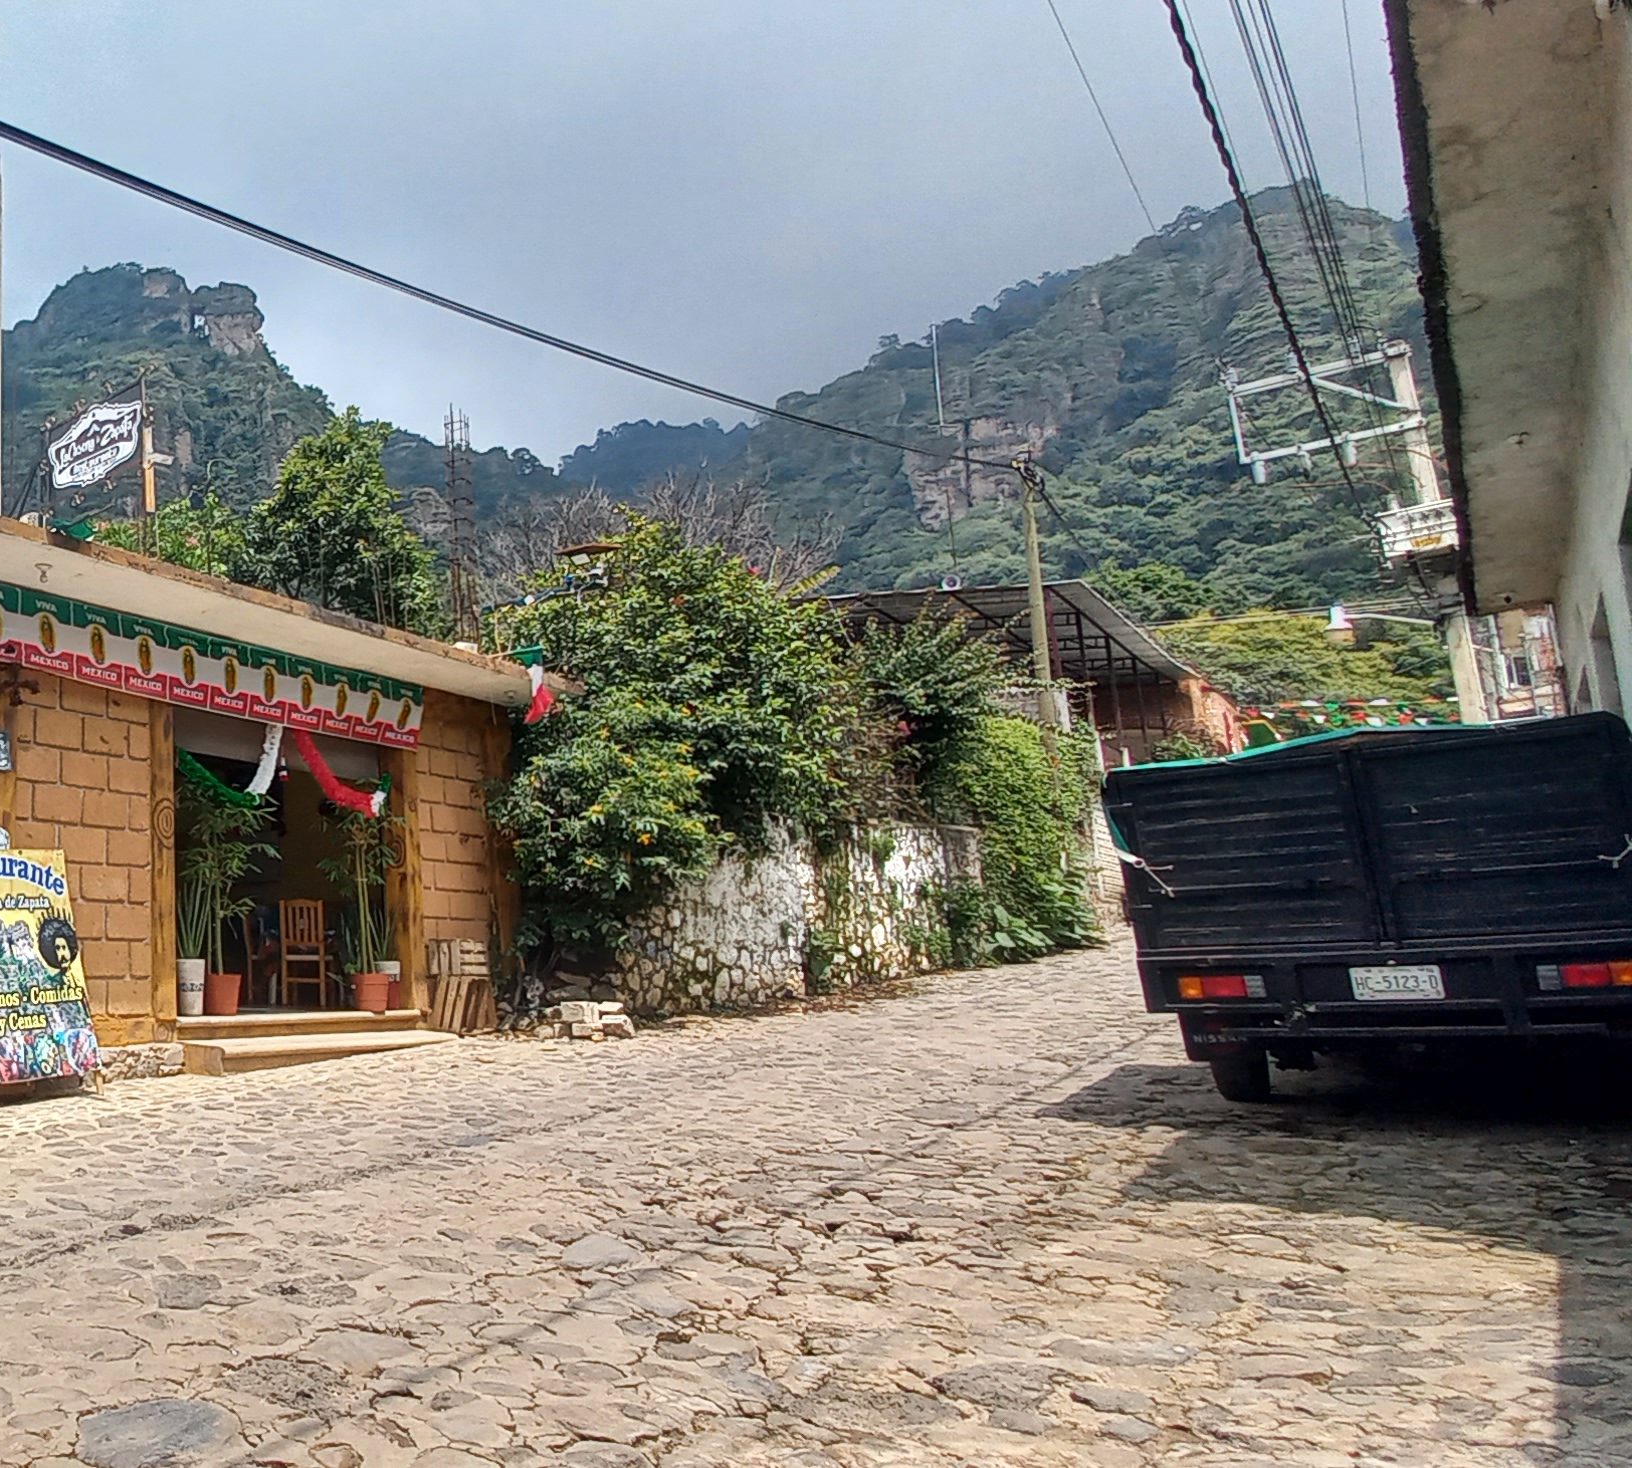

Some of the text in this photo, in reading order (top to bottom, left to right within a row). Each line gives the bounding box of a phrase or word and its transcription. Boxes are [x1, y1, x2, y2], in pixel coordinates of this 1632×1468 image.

[35, 600, 58, 613] VIVA
[85, 612, 107, 624] VIVA
[30, 654, 69, 671] MEXICO
[82, 665, 117, 682] MEXICO
[129, 676, 162, 692] MEXICO
[173, 686, 204, 701] MEXICO
[214, 695, 244, 709] MEXICO
[253, 703, 282, 717] MEXICO
[4, 896, 16, 910] de
[18, 895, 50, 912] Zapata
[1354, 974, 1439, 991] HC-5123-D
[30, 985, 83, 1005] Comidas
[9, 1013, 47, 1031] Cenas
